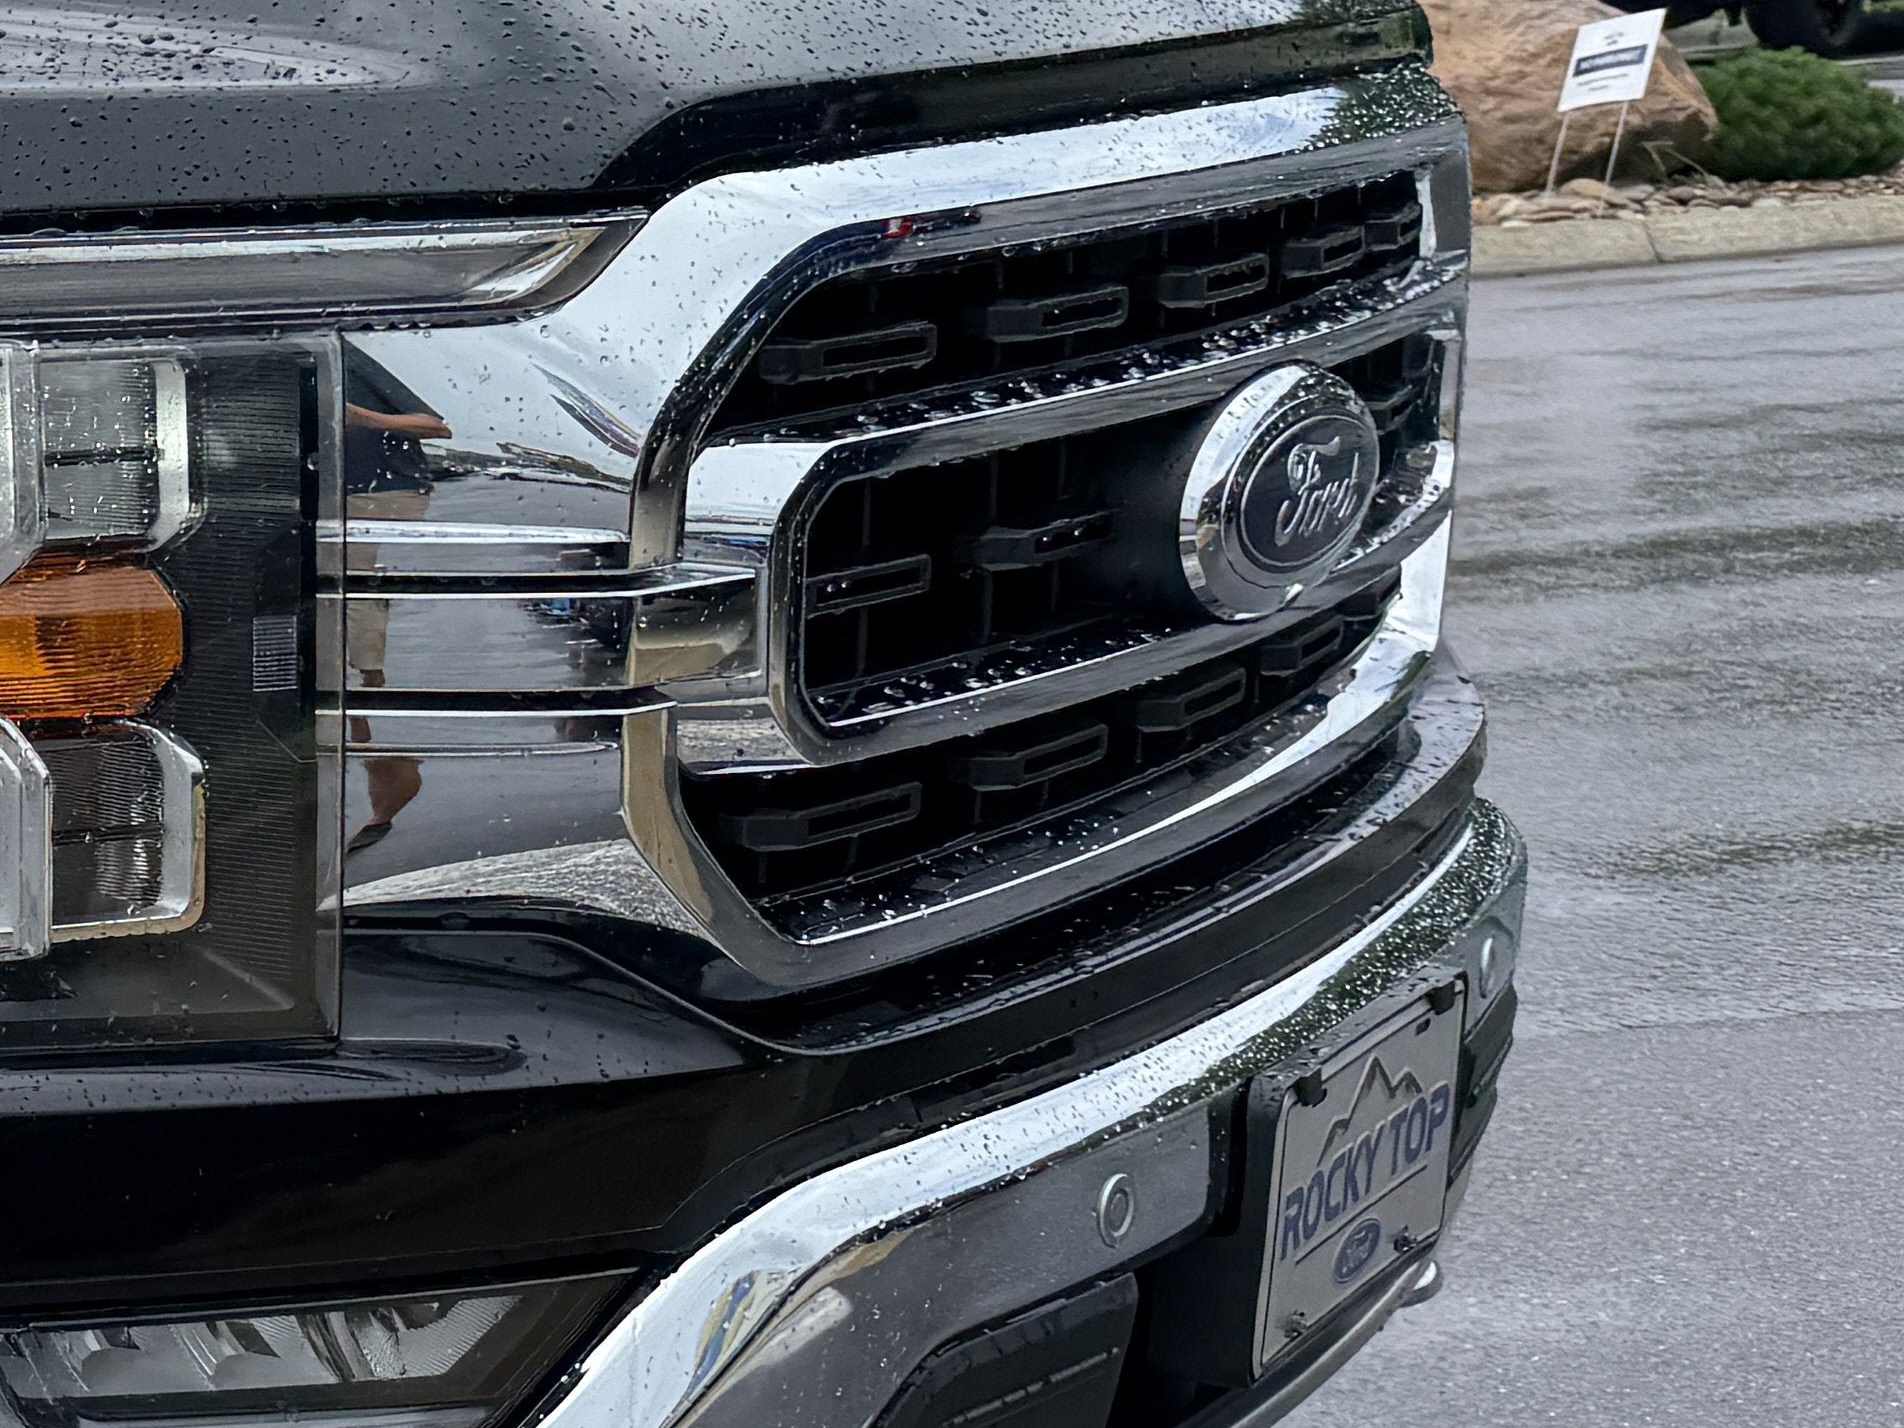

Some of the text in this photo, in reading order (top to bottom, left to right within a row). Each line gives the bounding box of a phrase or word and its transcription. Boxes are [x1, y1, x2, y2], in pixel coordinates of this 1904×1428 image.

[1273, 435, 1360, 548] Ford
[1279, 1080, 1451, 1261] ROCKY TOP
